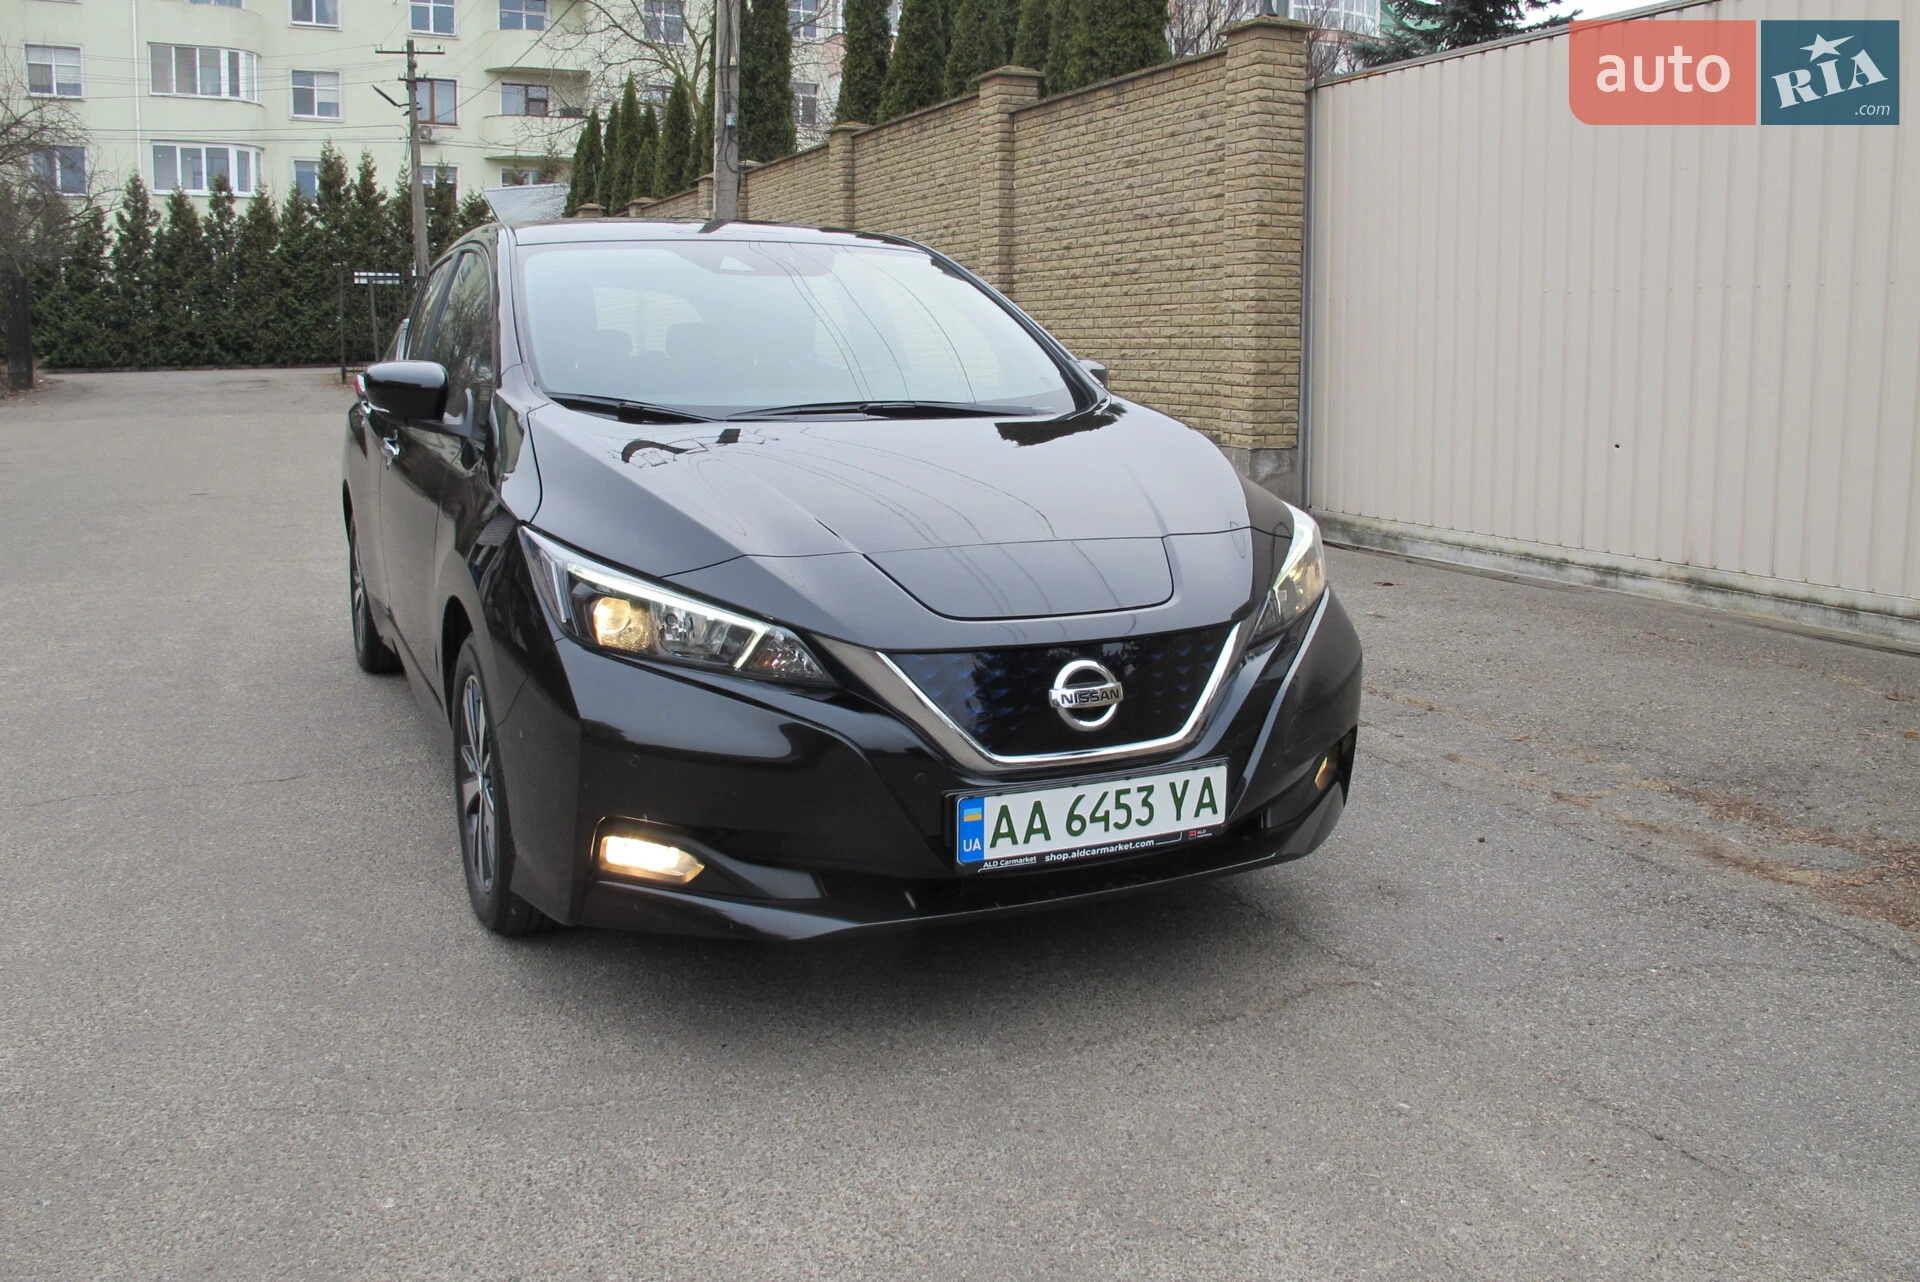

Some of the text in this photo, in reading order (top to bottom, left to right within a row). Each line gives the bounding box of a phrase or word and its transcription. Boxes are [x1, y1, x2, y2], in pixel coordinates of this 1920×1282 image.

[1061, 688, 1119, 705] NISSAN
[989, 776, 1218, 848] AA 6453 YA
[963, 838, 982, 852] UA
[1045, 839, 1155, 863] shop.aldcarmarket.com
[983, 856, 1037, 869] ALD Carmarket
